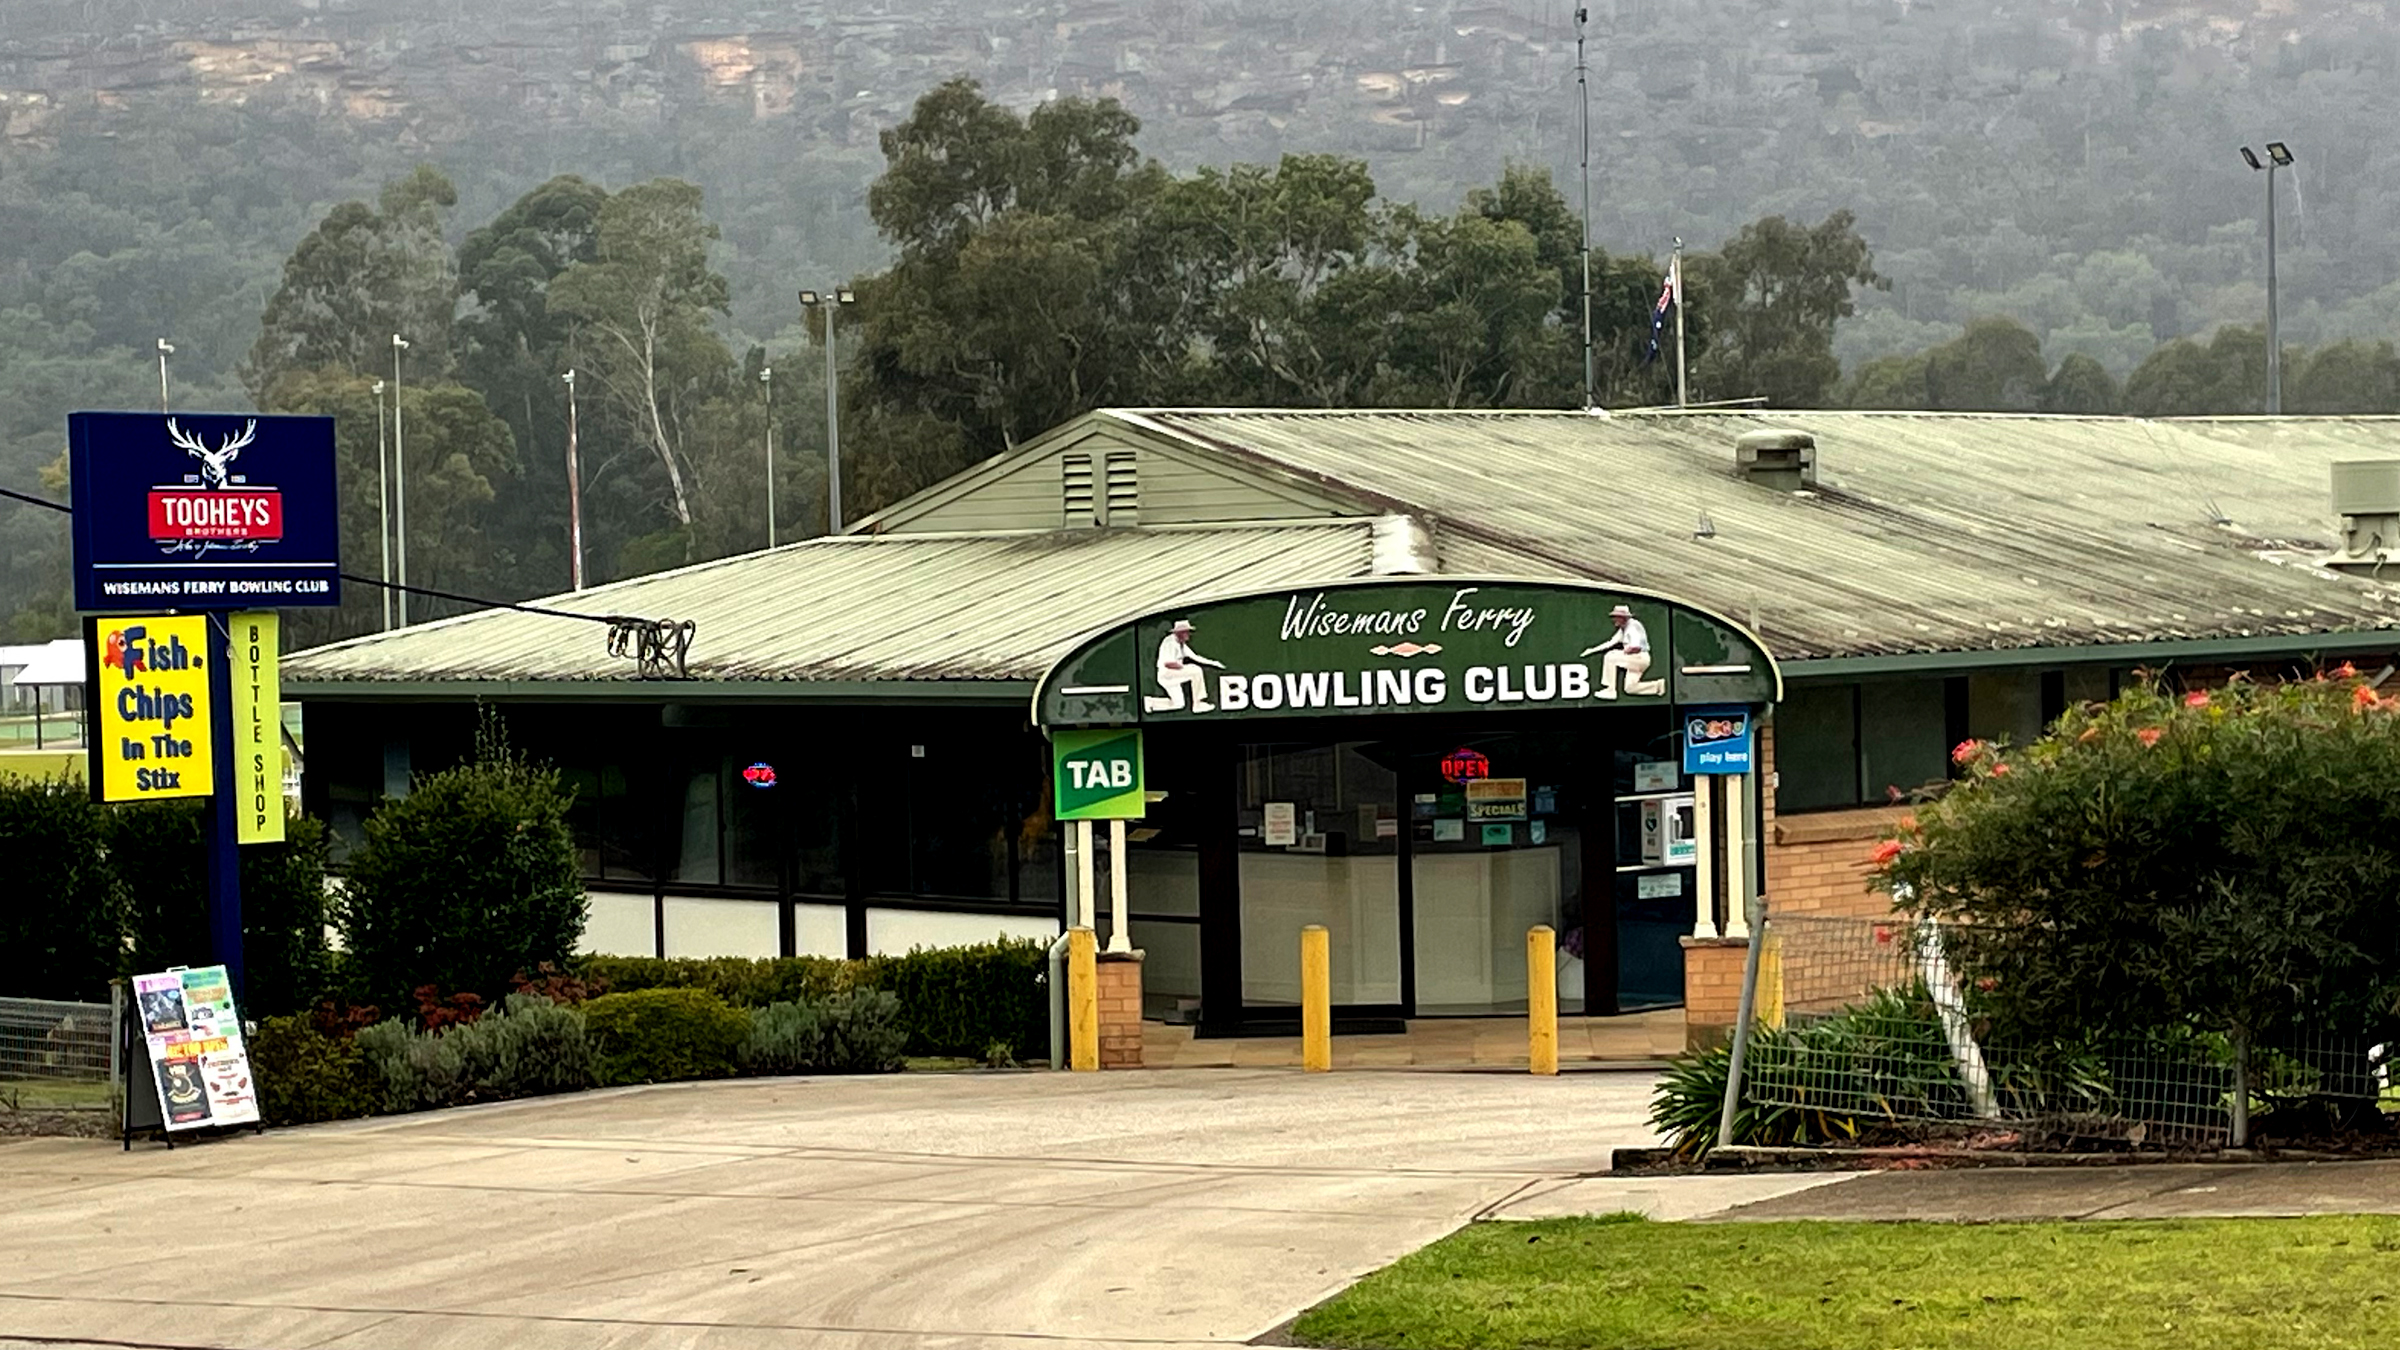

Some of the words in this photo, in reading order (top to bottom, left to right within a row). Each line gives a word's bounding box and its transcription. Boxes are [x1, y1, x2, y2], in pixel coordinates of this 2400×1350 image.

[161, 498, 270, 526] TOOHEYS
[103, 581, 180, 595] WISEMANS
[183, 581, 226, 594] FERRY
[229, 580, 292, 594] BOWLING
[295, 579, 330, 593] CLUB
[1280, 592, 1427, 640] Wisemans
[1440, 587, 1536, 648] Ferry
[249, 625, 262, 743] BOTTLE
[1219, 668, 1447, 711] BOWLING
[1464, 663, 1592, 702] CLUB
[117, 685, 194, 730] Chips
[121, 737, 146, 760] In
[151, 734, 193, 758] The
[1699, 751, 1723, 765] play
[136, 767, 182, 791] Stix
[1066, 760, 1132, 789] TAB
[1441, 759, 1489, 777] OPEN
[254, 754, 266, 832] SHOP
[1470, 803, 1525, 817] SPECIALS
